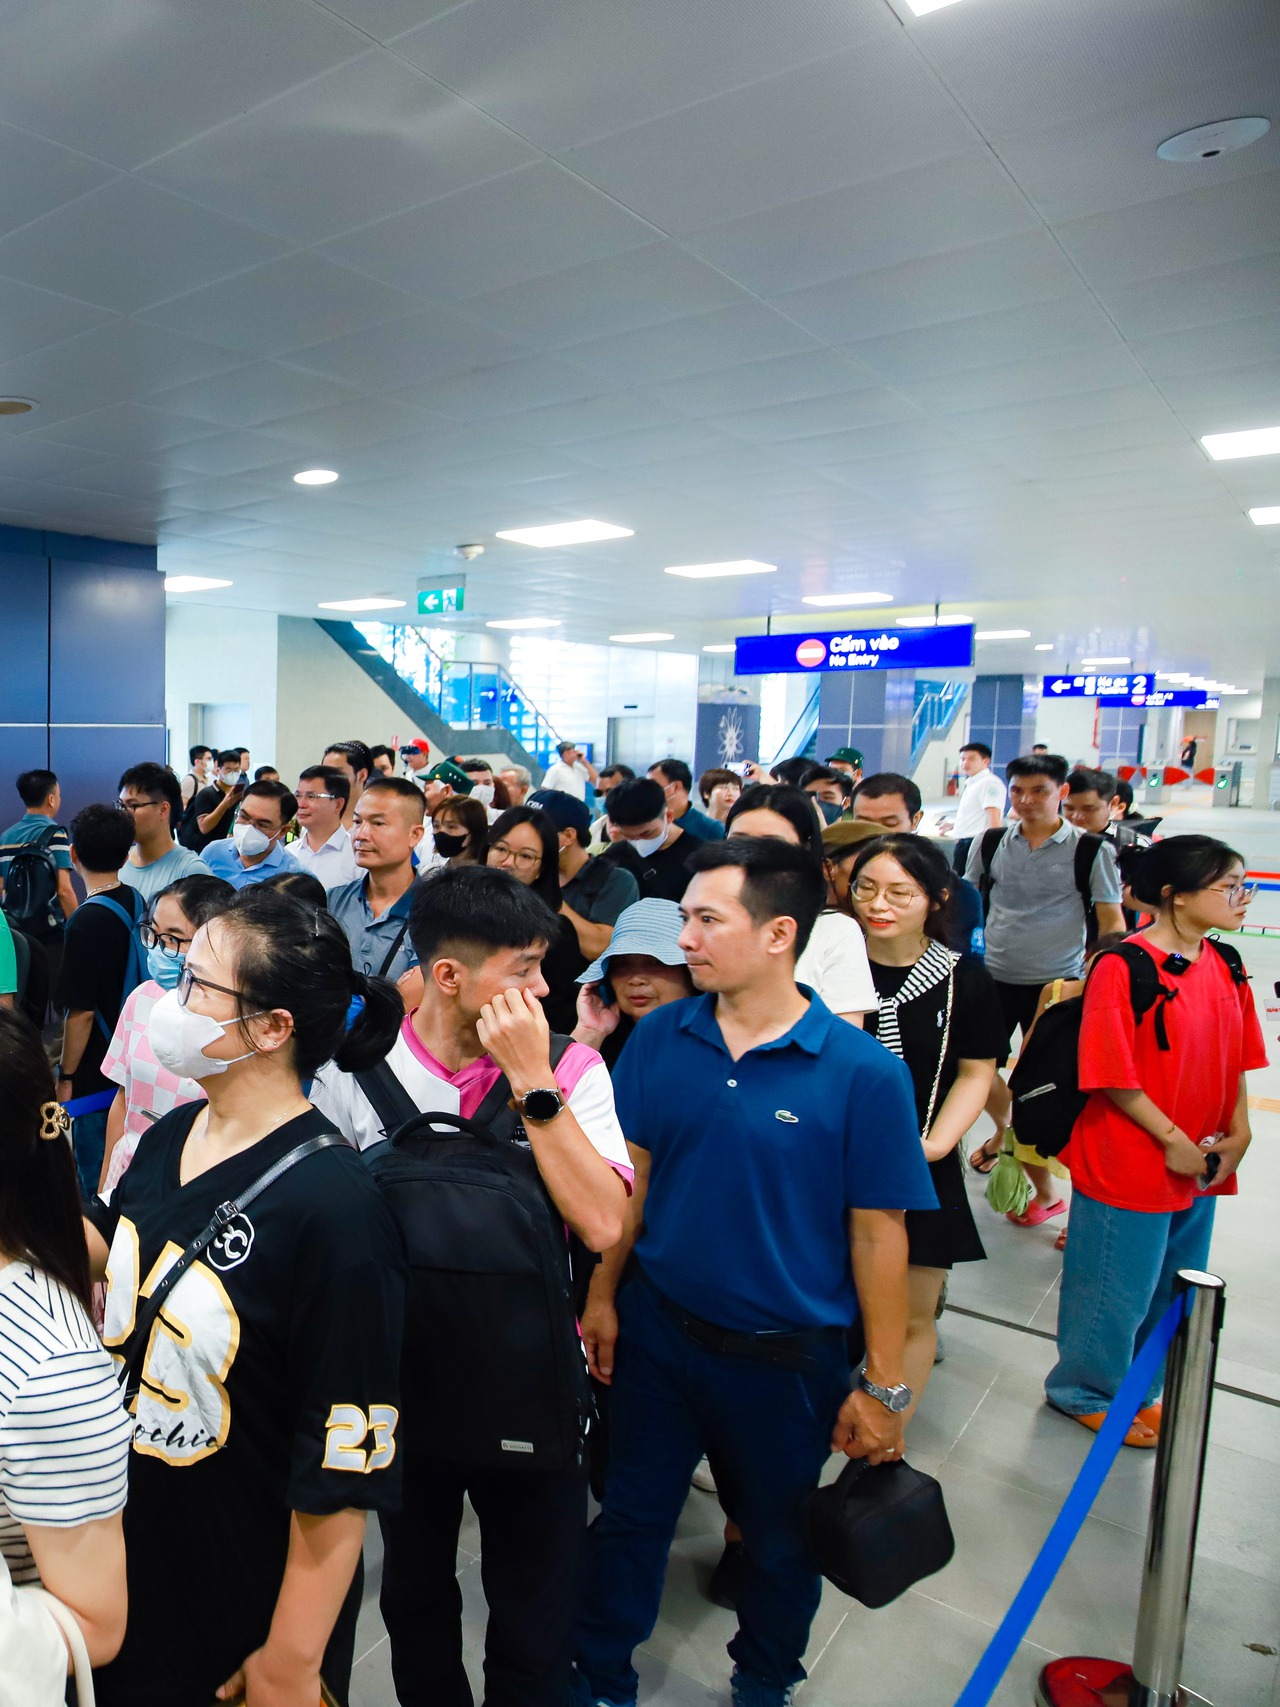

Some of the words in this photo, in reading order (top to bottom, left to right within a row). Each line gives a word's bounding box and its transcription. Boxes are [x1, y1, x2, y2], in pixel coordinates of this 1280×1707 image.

[870, 633, 899, 651] vào
[829, 654, 846, 667] No
[848, 653, 879, 667] Entry
[1131, 675, 1147, 694] 2
[322, 1403, 399, 1474] 23
